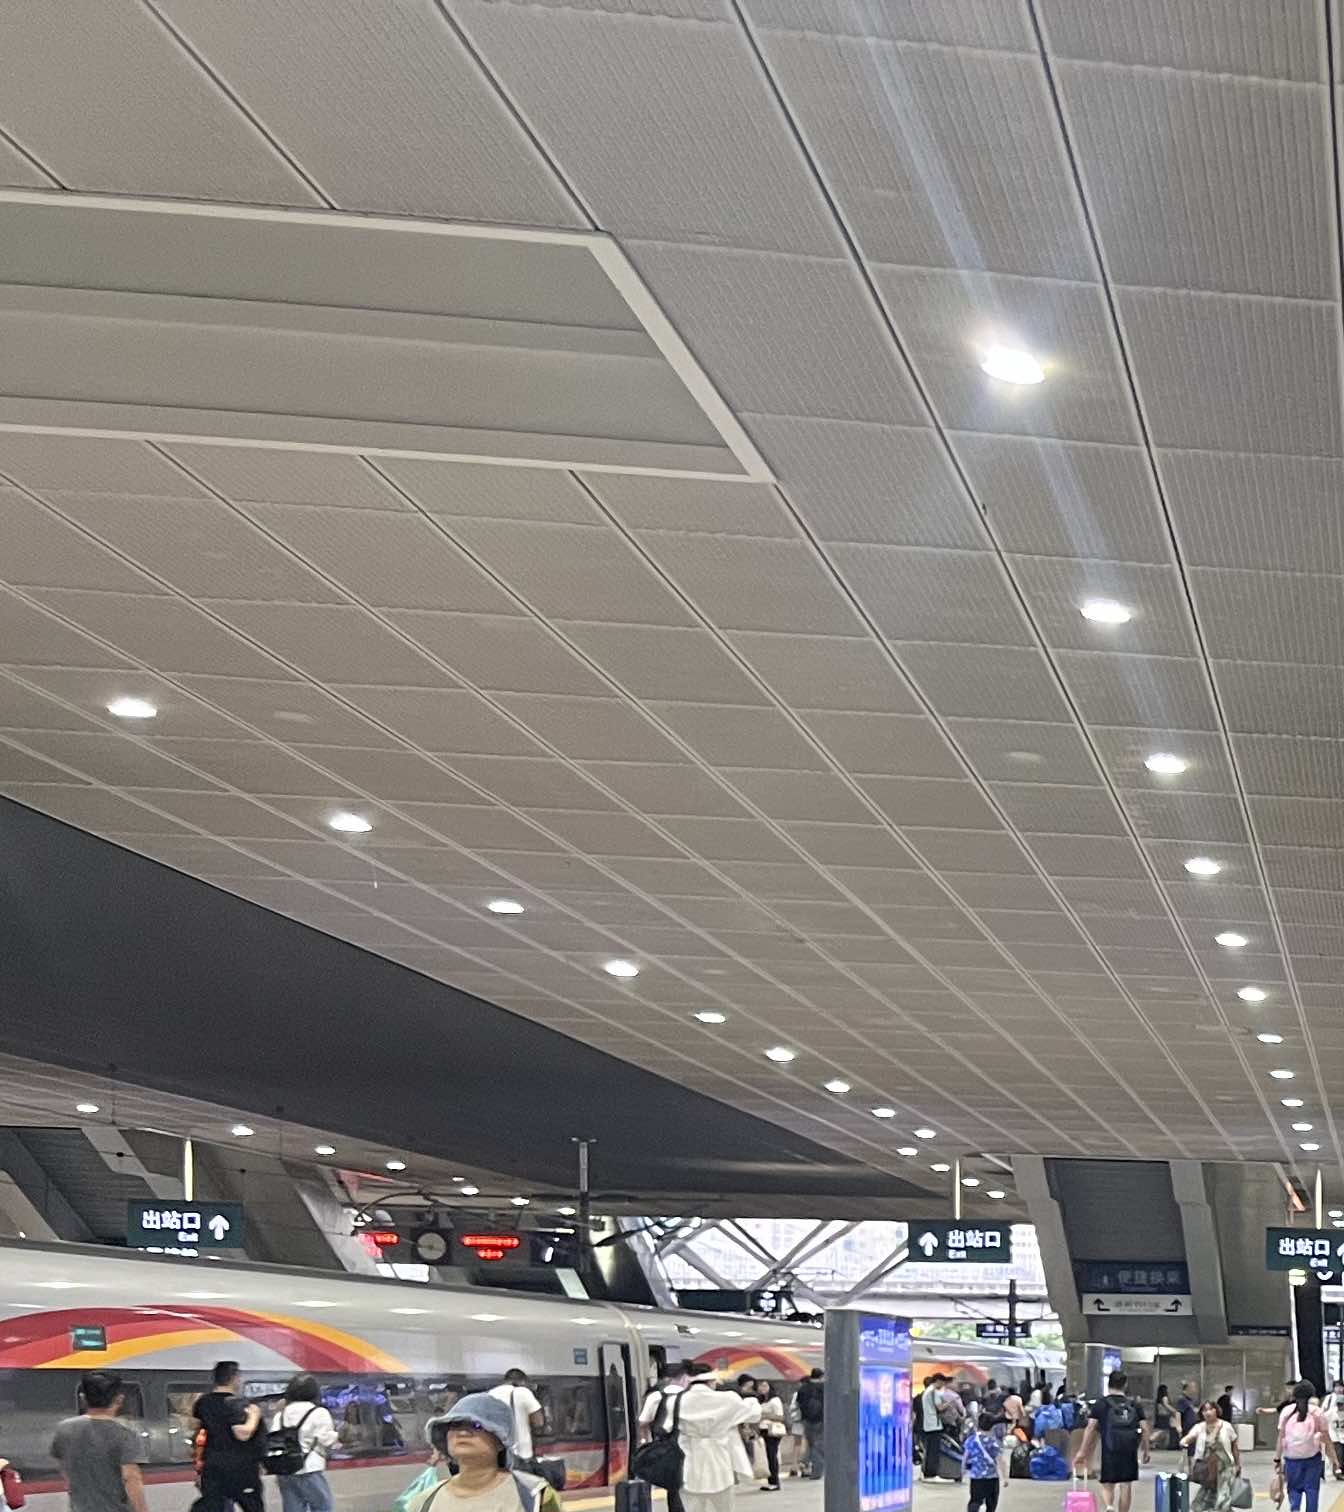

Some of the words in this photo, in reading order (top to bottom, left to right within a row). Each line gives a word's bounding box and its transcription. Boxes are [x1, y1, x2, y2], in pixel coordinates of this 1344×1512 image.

[142, 1210, 201, 1230] 出站口
[947, 1229, 1001, 1248] 出站口
[1279, 1237, 1330, 1256] 出站口
